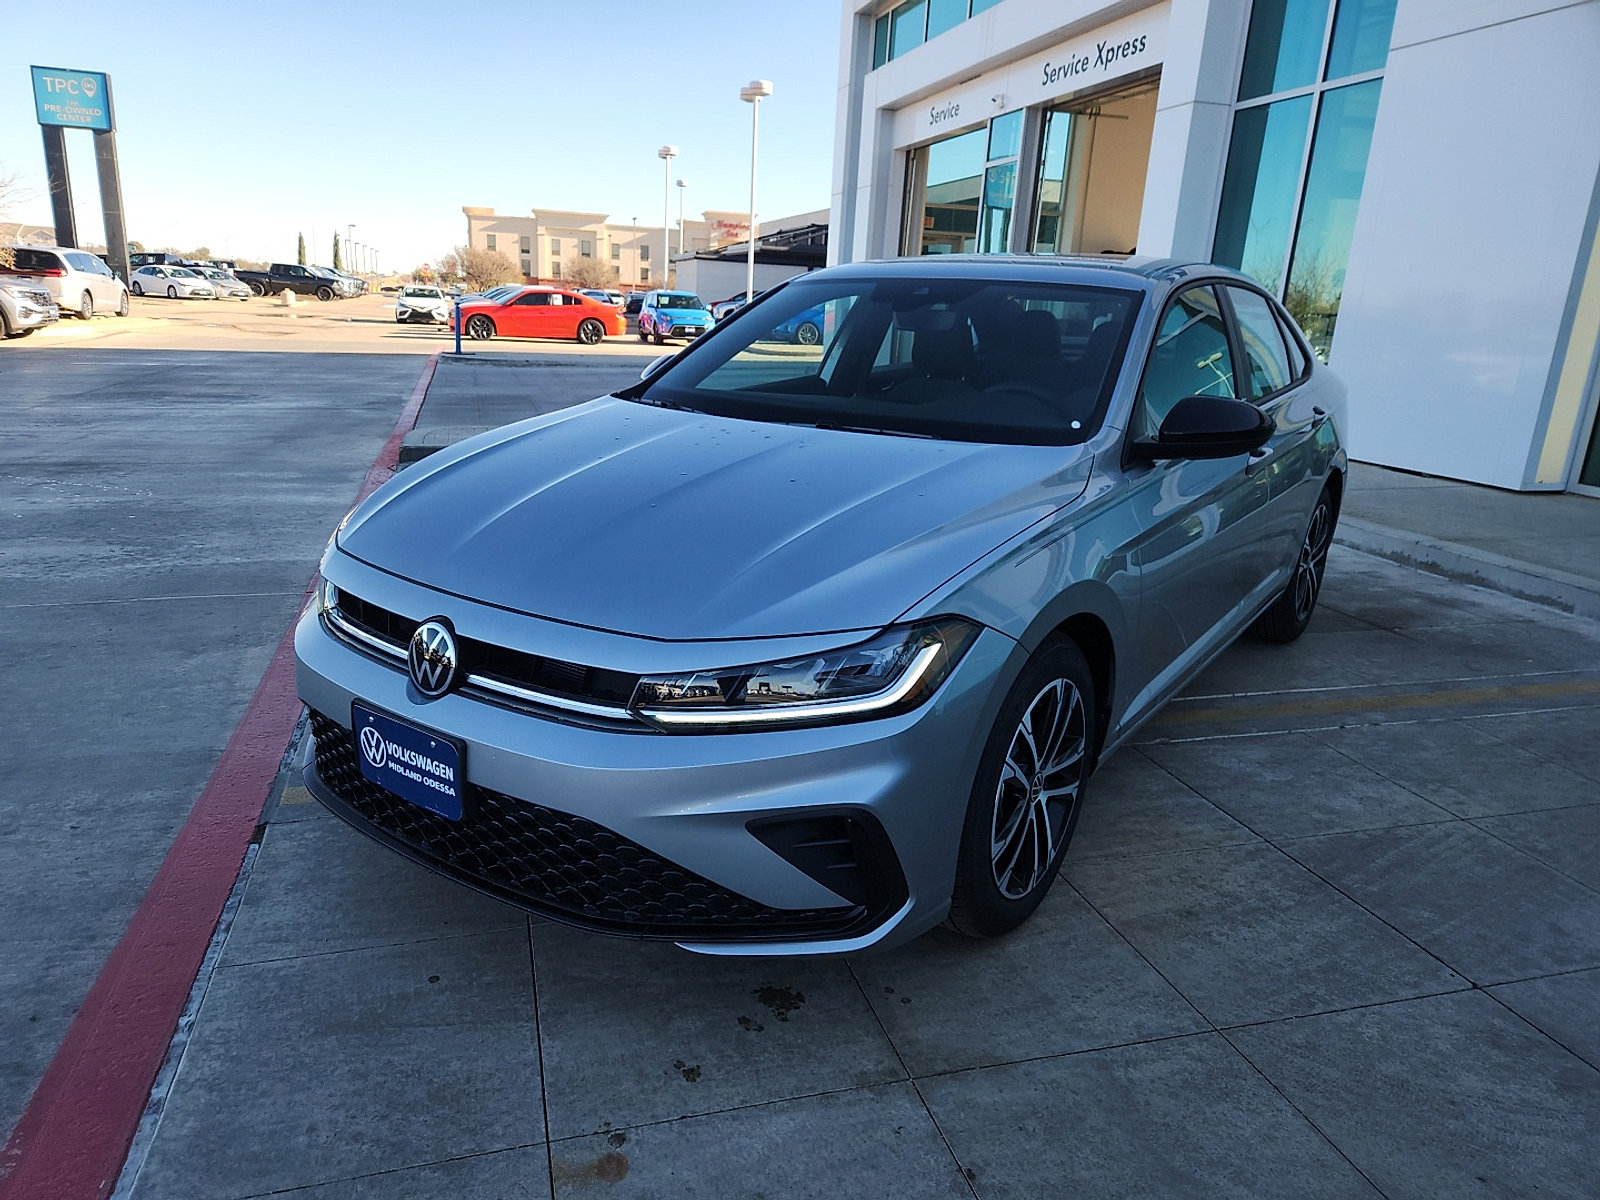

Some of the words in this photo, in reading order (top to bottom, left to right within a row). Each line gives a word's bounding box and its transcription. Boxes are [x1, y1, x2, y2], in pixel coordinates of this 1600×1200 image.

[1042, 53, 1089, 86] Service
[1094, 35, 1147, 71] Xpress
[42, 77, 79, 95] TPC
[56, 113, 92, 123] CENTER
[929, 102, 960, 125] Service
[361, 727, 386, 767] VW
[386, 740, 454, 782] VOLKSWAGEN
[388, 760, 423, 783] MIDLAND
[423, 776, 456, 797] ODESSA
